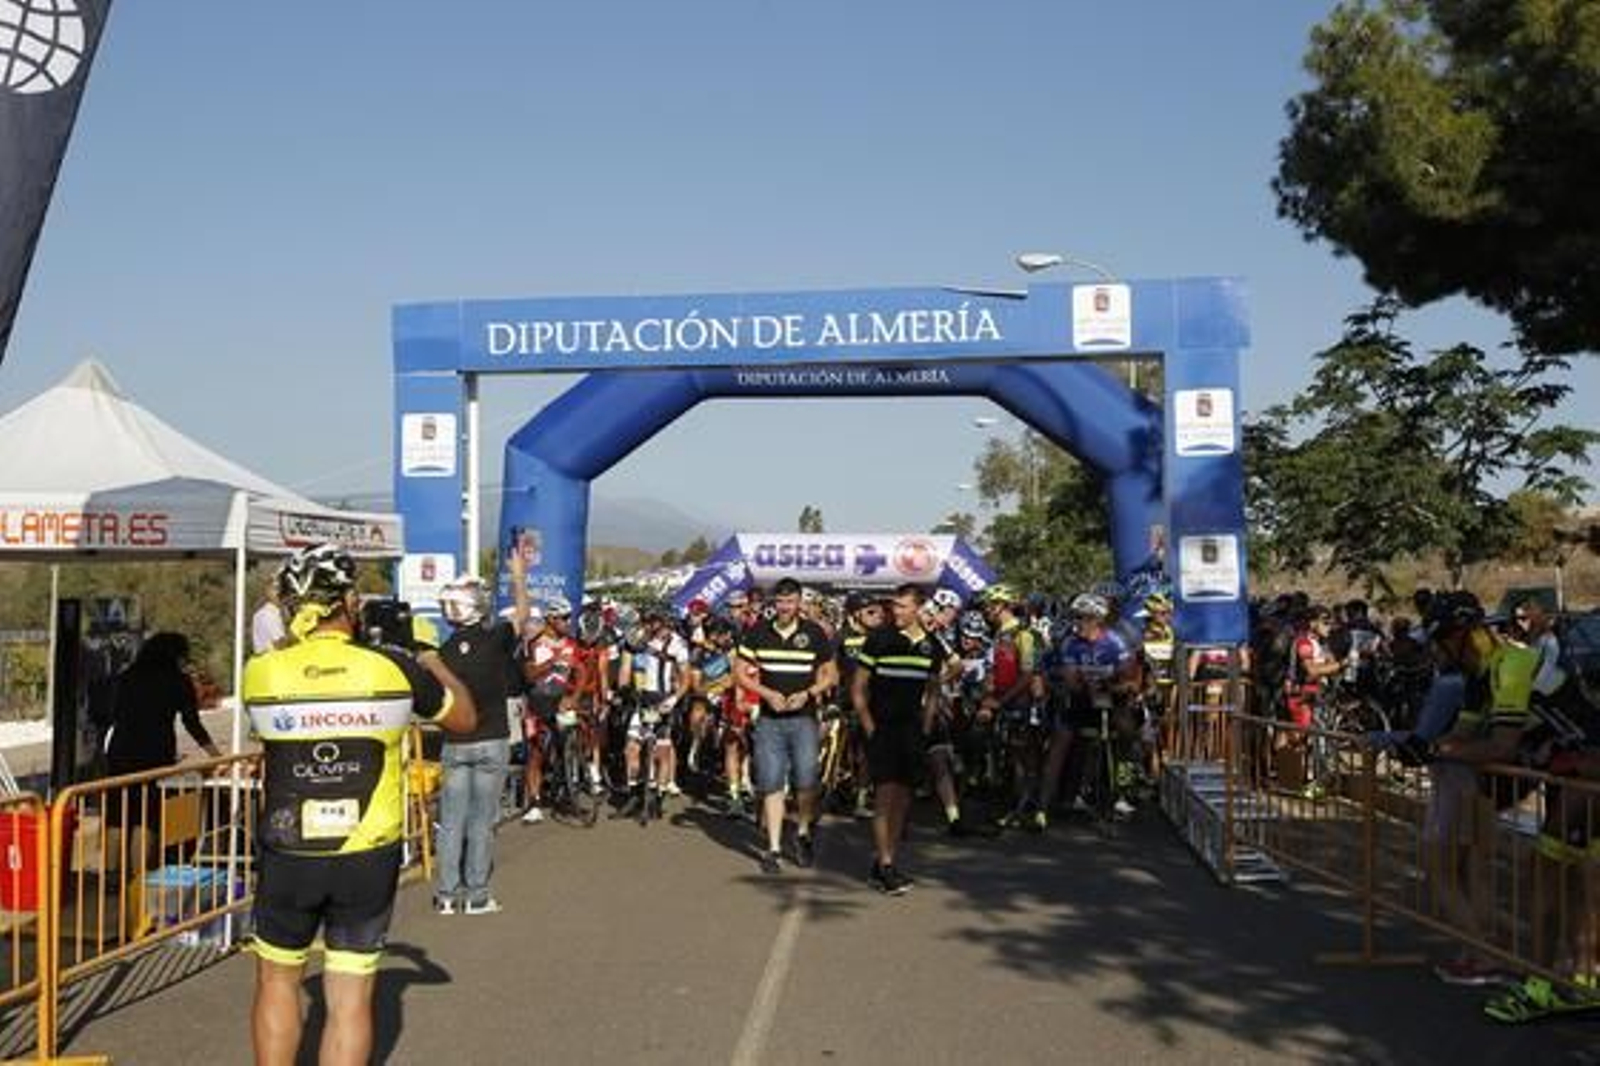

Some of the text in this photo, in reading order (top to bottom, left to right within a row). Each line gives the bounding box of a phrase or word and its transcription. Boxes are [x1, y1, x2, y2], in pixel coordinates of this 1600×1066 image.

[487, 301, 1004, 355] DIPUTACIÓN DE ALMERÍA
[738, 369, 950, 386] DIPUTACIÓN DE ALMERÍA
[755, 544, 845, 568] asisa
[301, 713, 382, 728] INCOAL
